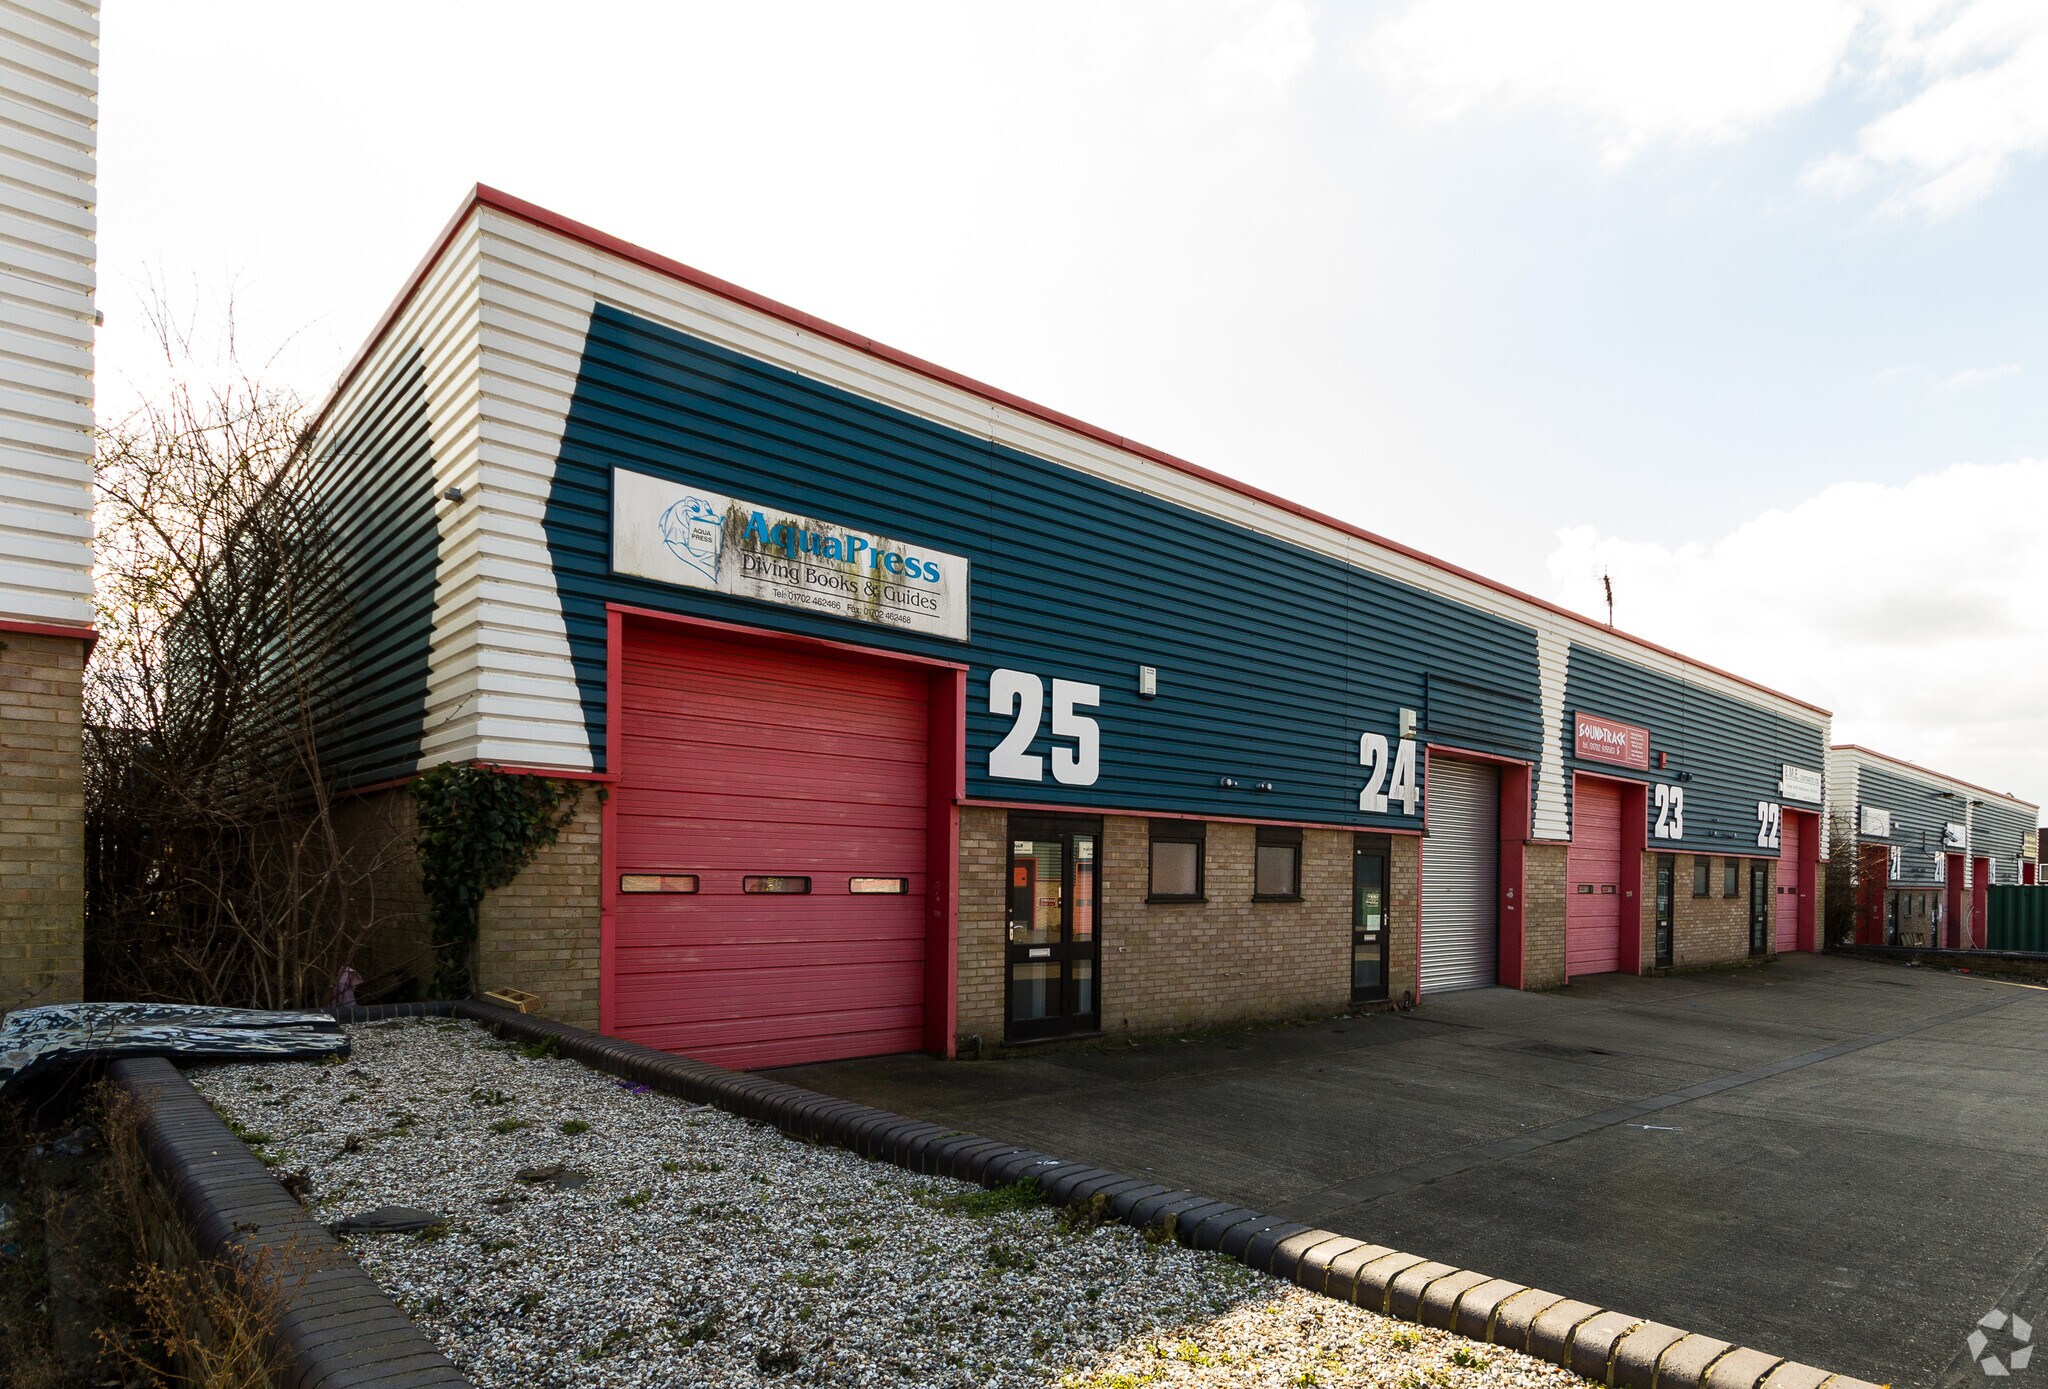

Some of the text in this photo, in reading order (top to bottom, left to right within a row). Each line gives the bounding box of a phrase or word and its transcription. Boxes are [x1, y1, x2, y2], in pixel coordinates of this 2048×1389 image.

[691, 534, 713, 544] PRESS
[692, 527, 712, 537] AQUA
[742, 511, 941, 584] AquaPress
[743, 553, 937, 610] Diving Books & Guides
[788, 592, 811, 603] 01702
[863, 608, 884, 618] 01702
[989, 668, 1100, 786] 25
[1579, 723, 1625, 746] SOUNDTRACK
[1359, 732, 1420, 816] 24
[1655, 783, 1683, 839] 23
[1758, 801, 1779, 848] 22
